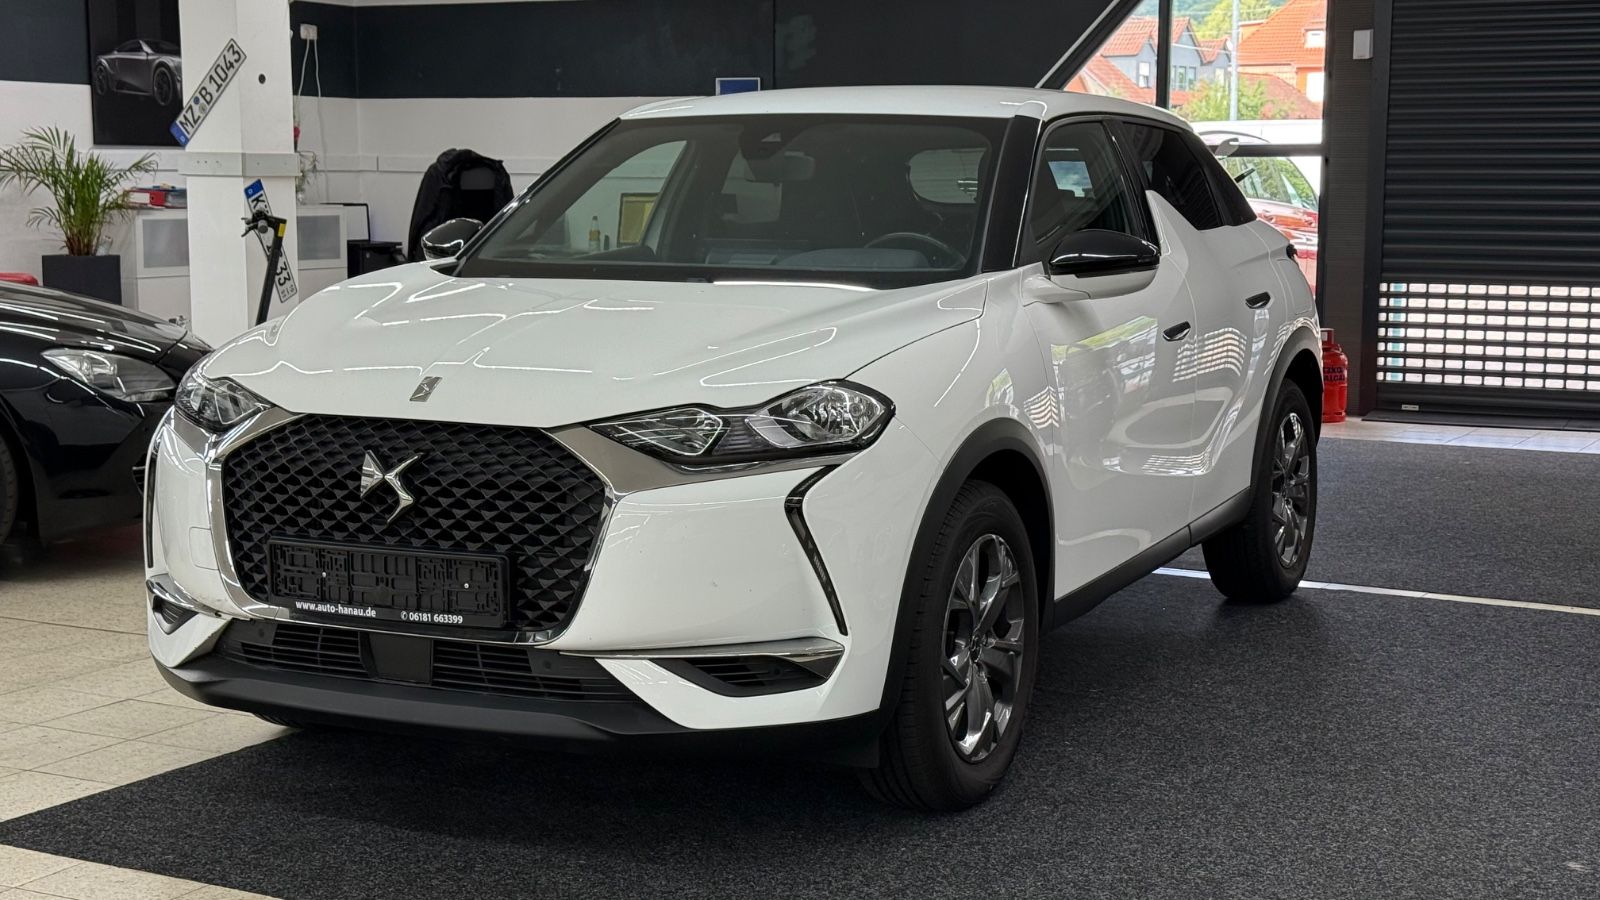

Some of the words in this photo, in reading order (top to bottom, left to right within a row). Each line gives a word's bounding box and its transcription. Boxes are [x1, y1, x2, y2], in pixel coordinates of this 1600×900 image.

[179, 104, 201, 135] MZ
[198, 86, 214, 107] B
[208, 43, 242, 93] 1043
[295, 601, 377, 617] www.auto-hanau.de
[408, 612, 432, 622] 06181
[433, 613, 464, 624] 663399
